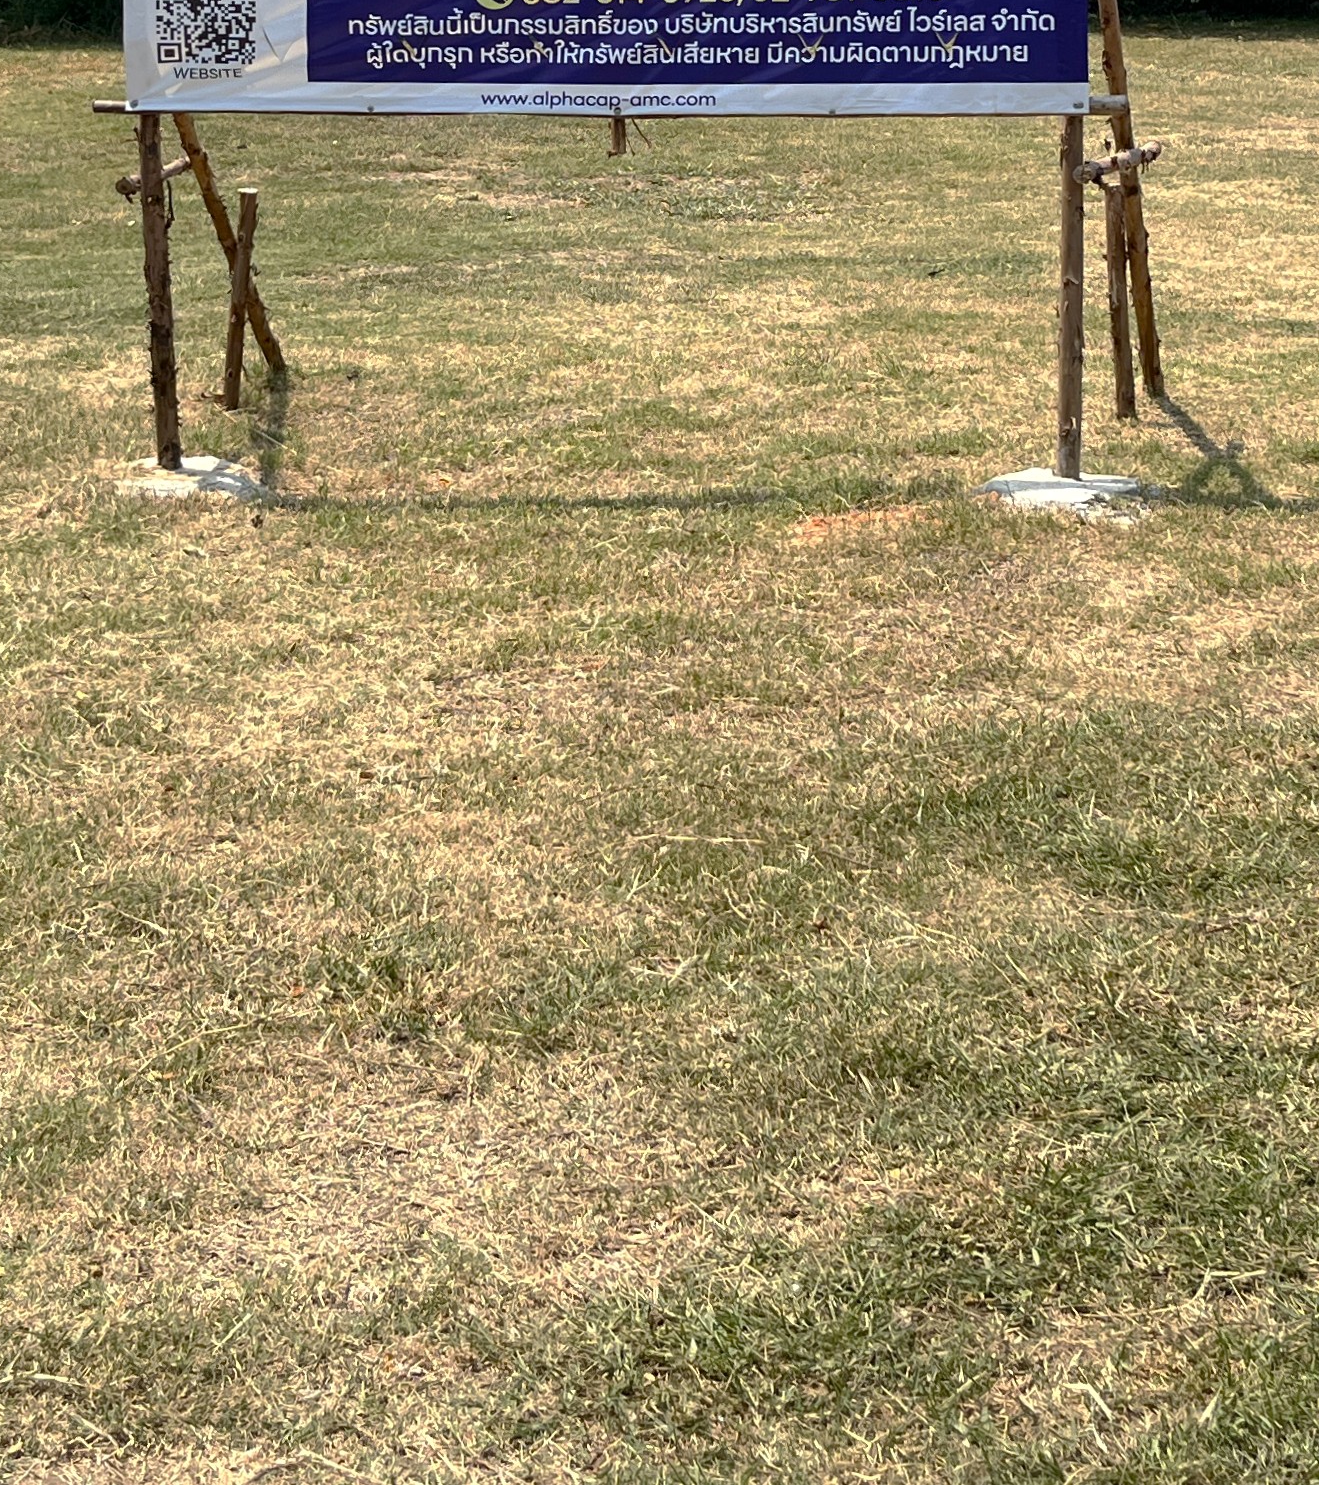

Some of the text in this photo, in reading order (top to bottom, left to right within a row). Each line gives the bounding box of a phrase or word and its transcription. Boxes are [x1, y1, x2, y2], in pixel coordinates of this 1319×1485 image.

[348, 6, 1056, 36] ทรัพย์สินนี้เป็นกรรมสิทธิ์ของ บริษัทบริหารสินทรัพย์ ไวร์เลส จำกัด
[366, 40, 473, 69] ผู้ใดบุกรุก
[481, 39, 760, 65] หรือทำให้ทรัพย์สินเสียหาย
[174, 67, 243, 80] WEBSITE
[481, 90, 717, 110] www.alphacap-amc.com
